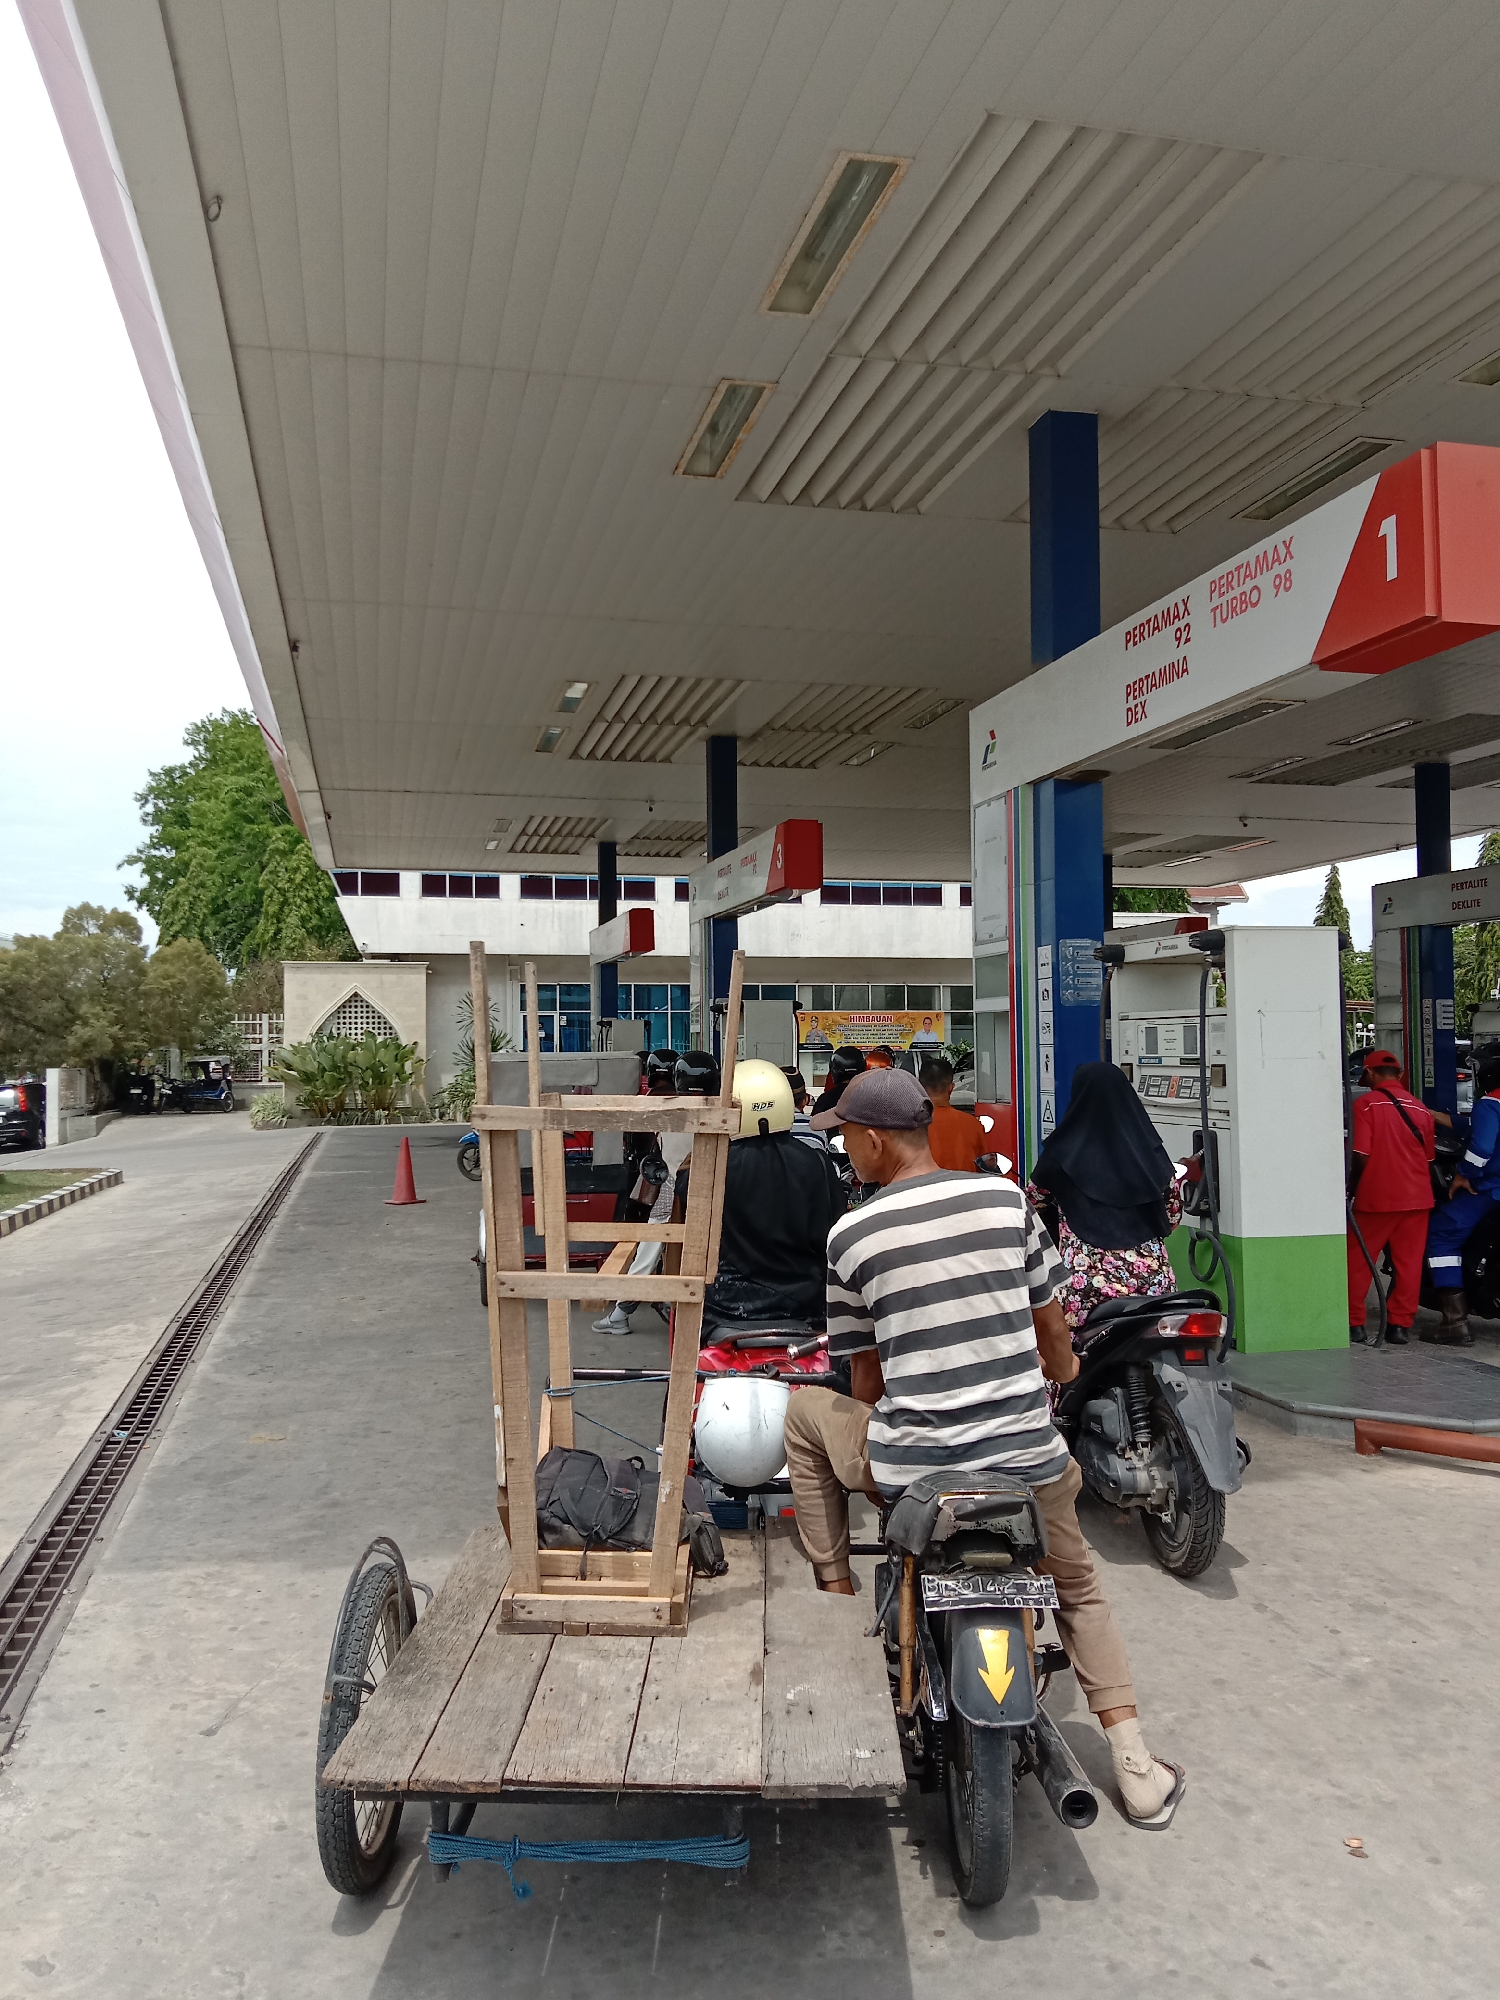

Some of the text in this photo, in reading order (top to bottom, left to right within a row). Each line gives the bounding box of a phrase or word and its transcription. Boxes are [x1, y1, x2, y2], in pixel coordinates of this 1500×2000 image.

[1378, 514, 1398, 582] 1
[1209, 536, 1295, 603] PERTAMAX
[1210, 568, 1293, 628] TURBO 98
[1125, 595, 1191, 651] PERTAMAX
[1174, 622, 1191, 649] 92
[1125, 655, 1189, 704] PERTAMINA
[1126, 699, 1148, 727] DEX
[776, 843, 783, 869] 3
[1451, 878, 1488, 891] PERTALITE
[1451, 899, 1481, 911] DEXLITE
[849, 1015, 893, 1023] HIMBAUAN
